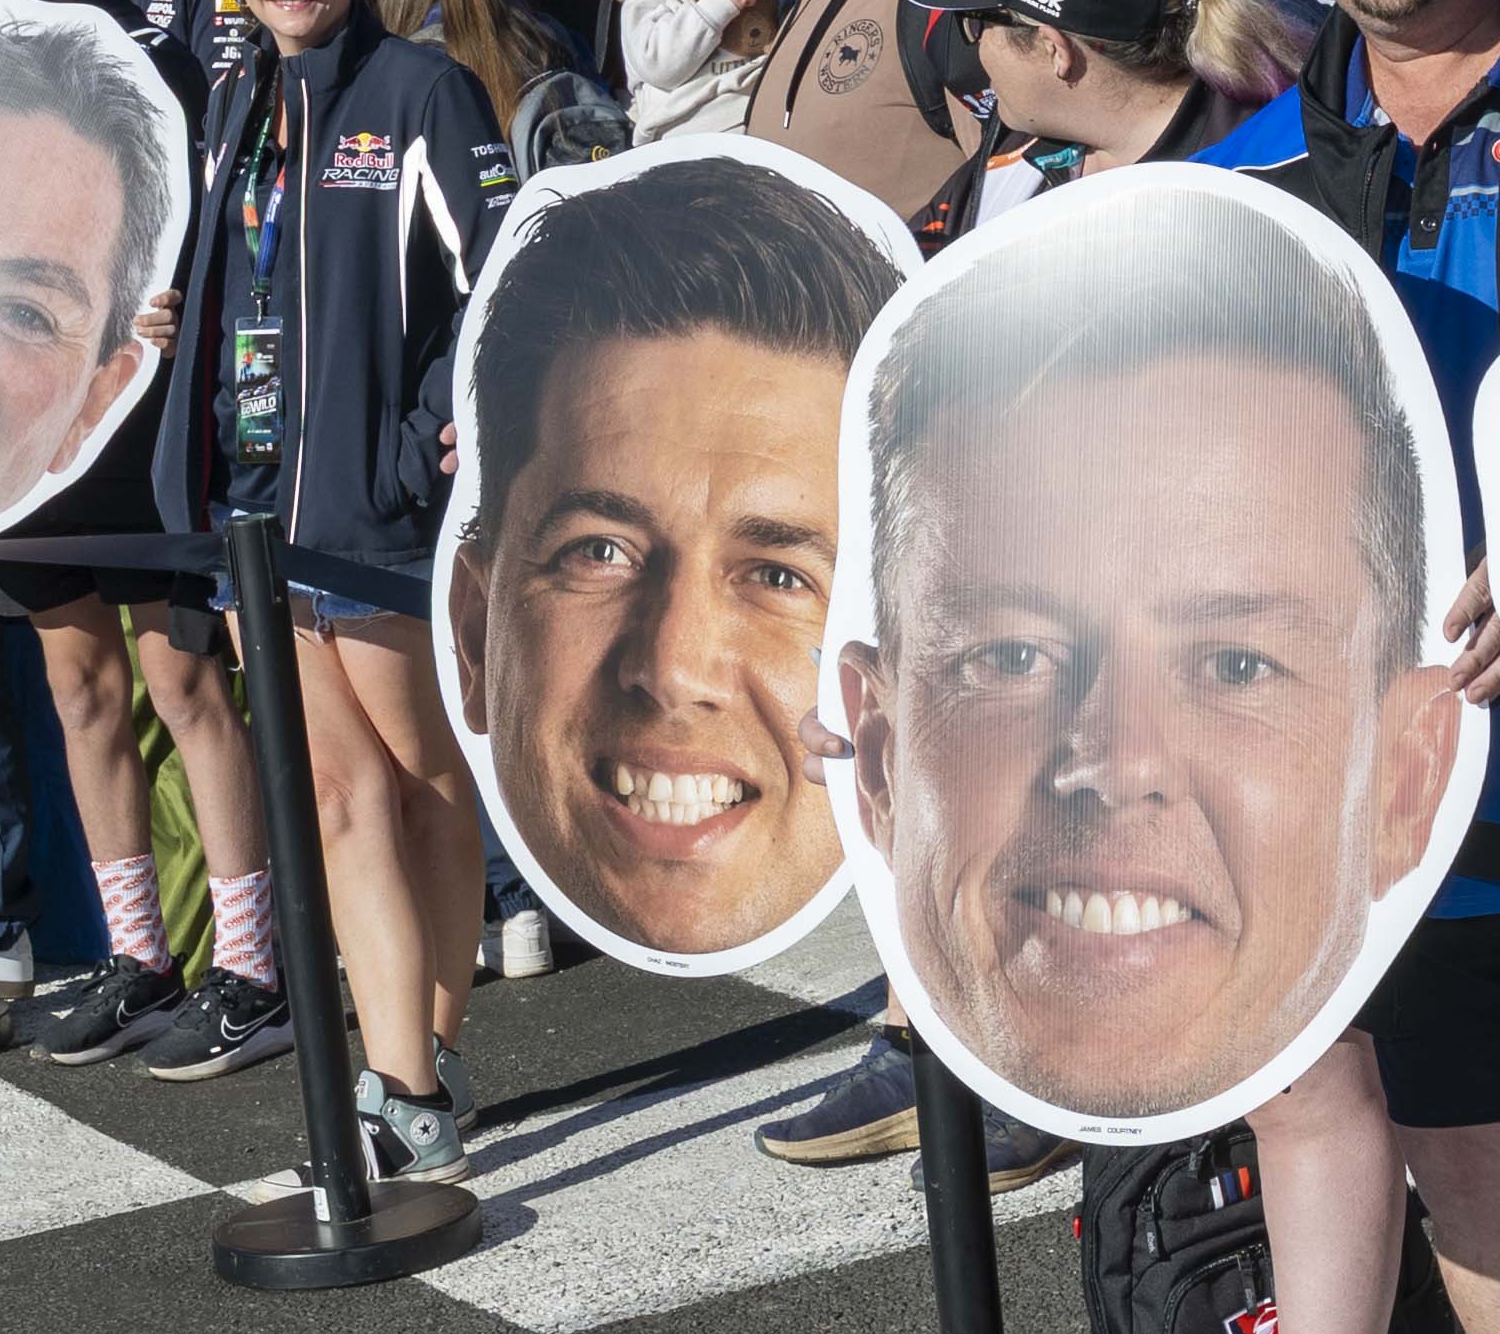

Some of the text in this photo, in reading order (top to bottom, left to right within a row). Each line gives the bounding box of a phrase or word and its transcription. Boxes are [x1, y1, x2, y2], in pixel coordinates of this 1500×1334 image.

[833, 19, 881, 47] RINGERS
[820, 65, 871, 92] WESTERN
[334, 152, 394, 169] Red Bull
[321, 168, 400, 180] RACING
[1107, 1127, 1143, 1135] COURTNEY
